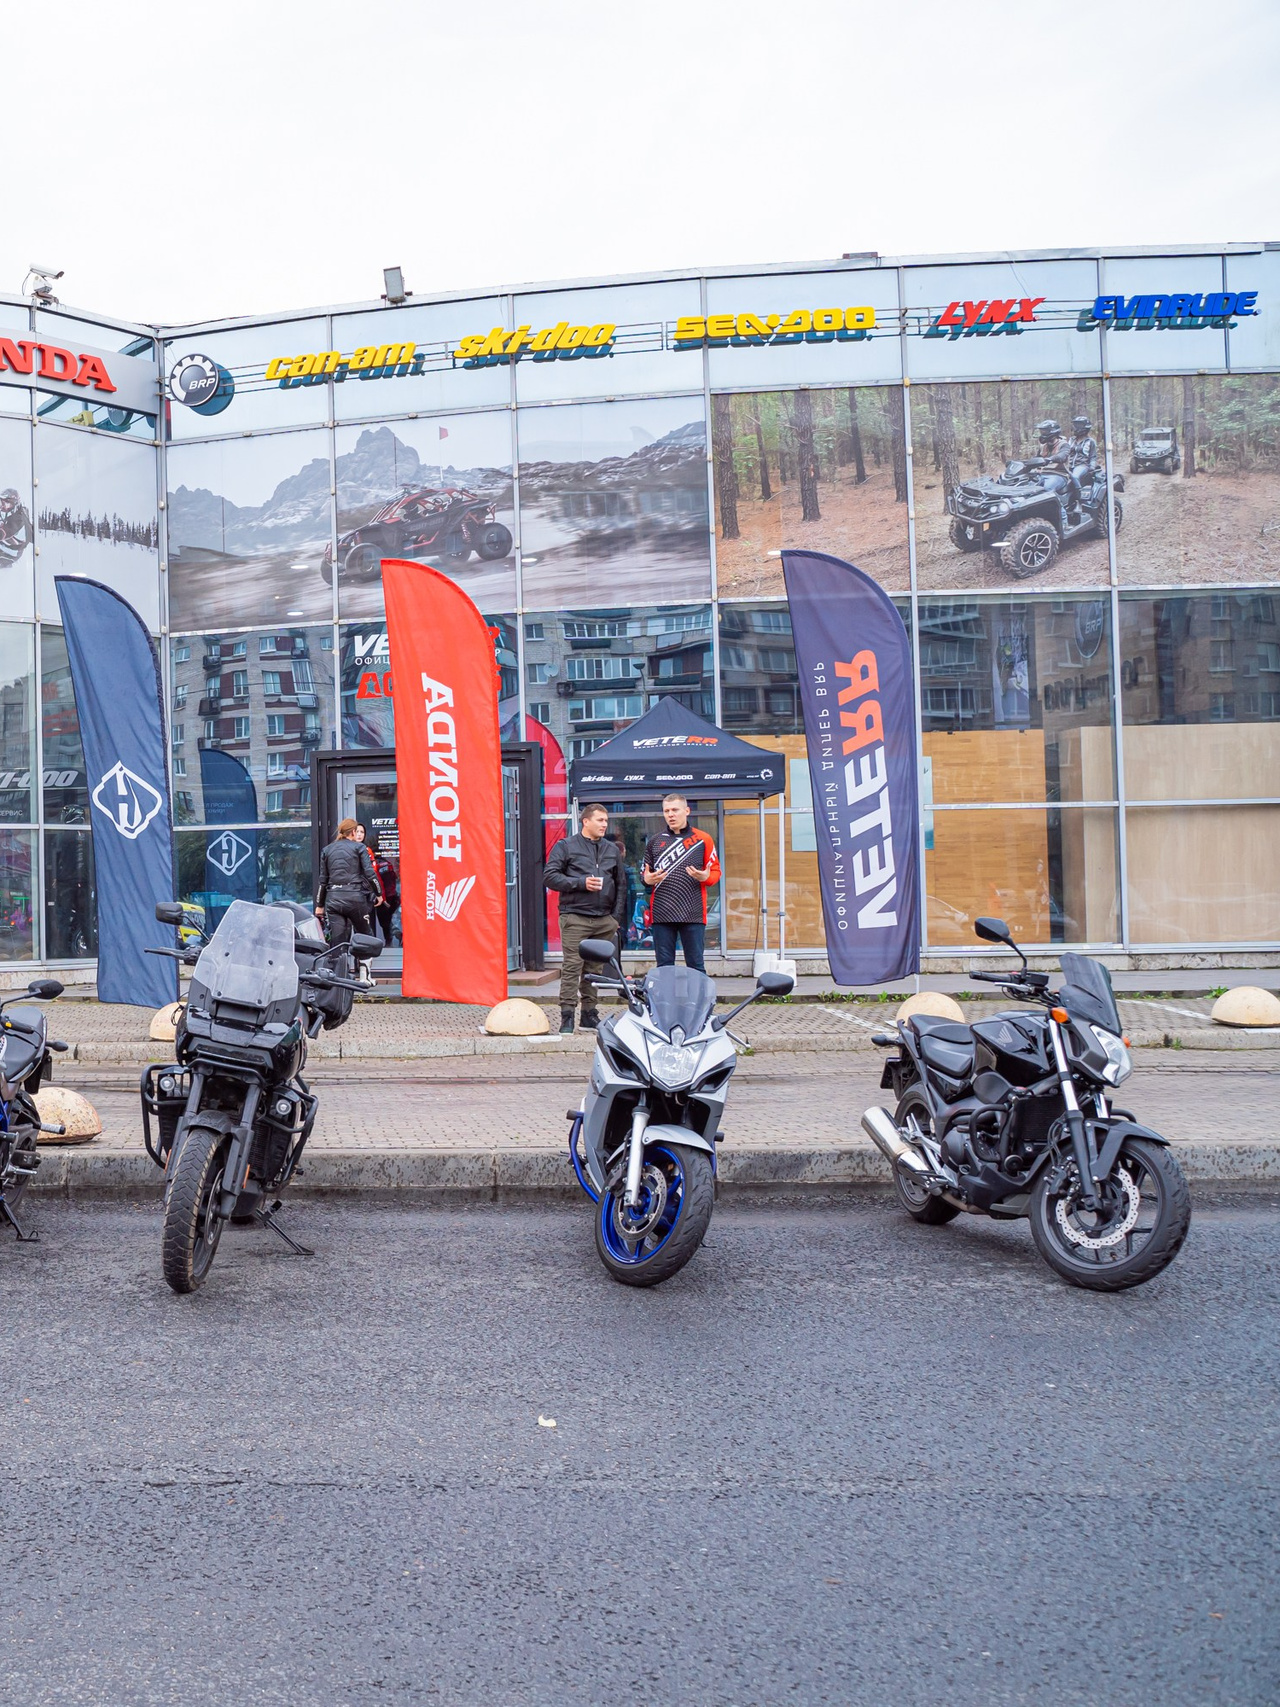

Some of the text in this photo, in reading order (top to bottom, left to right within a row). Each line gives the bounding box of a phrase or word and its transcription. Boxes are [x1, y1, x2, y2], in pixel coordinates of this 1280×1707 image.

[937, 297, 1046, 328] LYNX
[189, 378, 216, 390] BRP
[632, 735, 719, 747] VETERR
